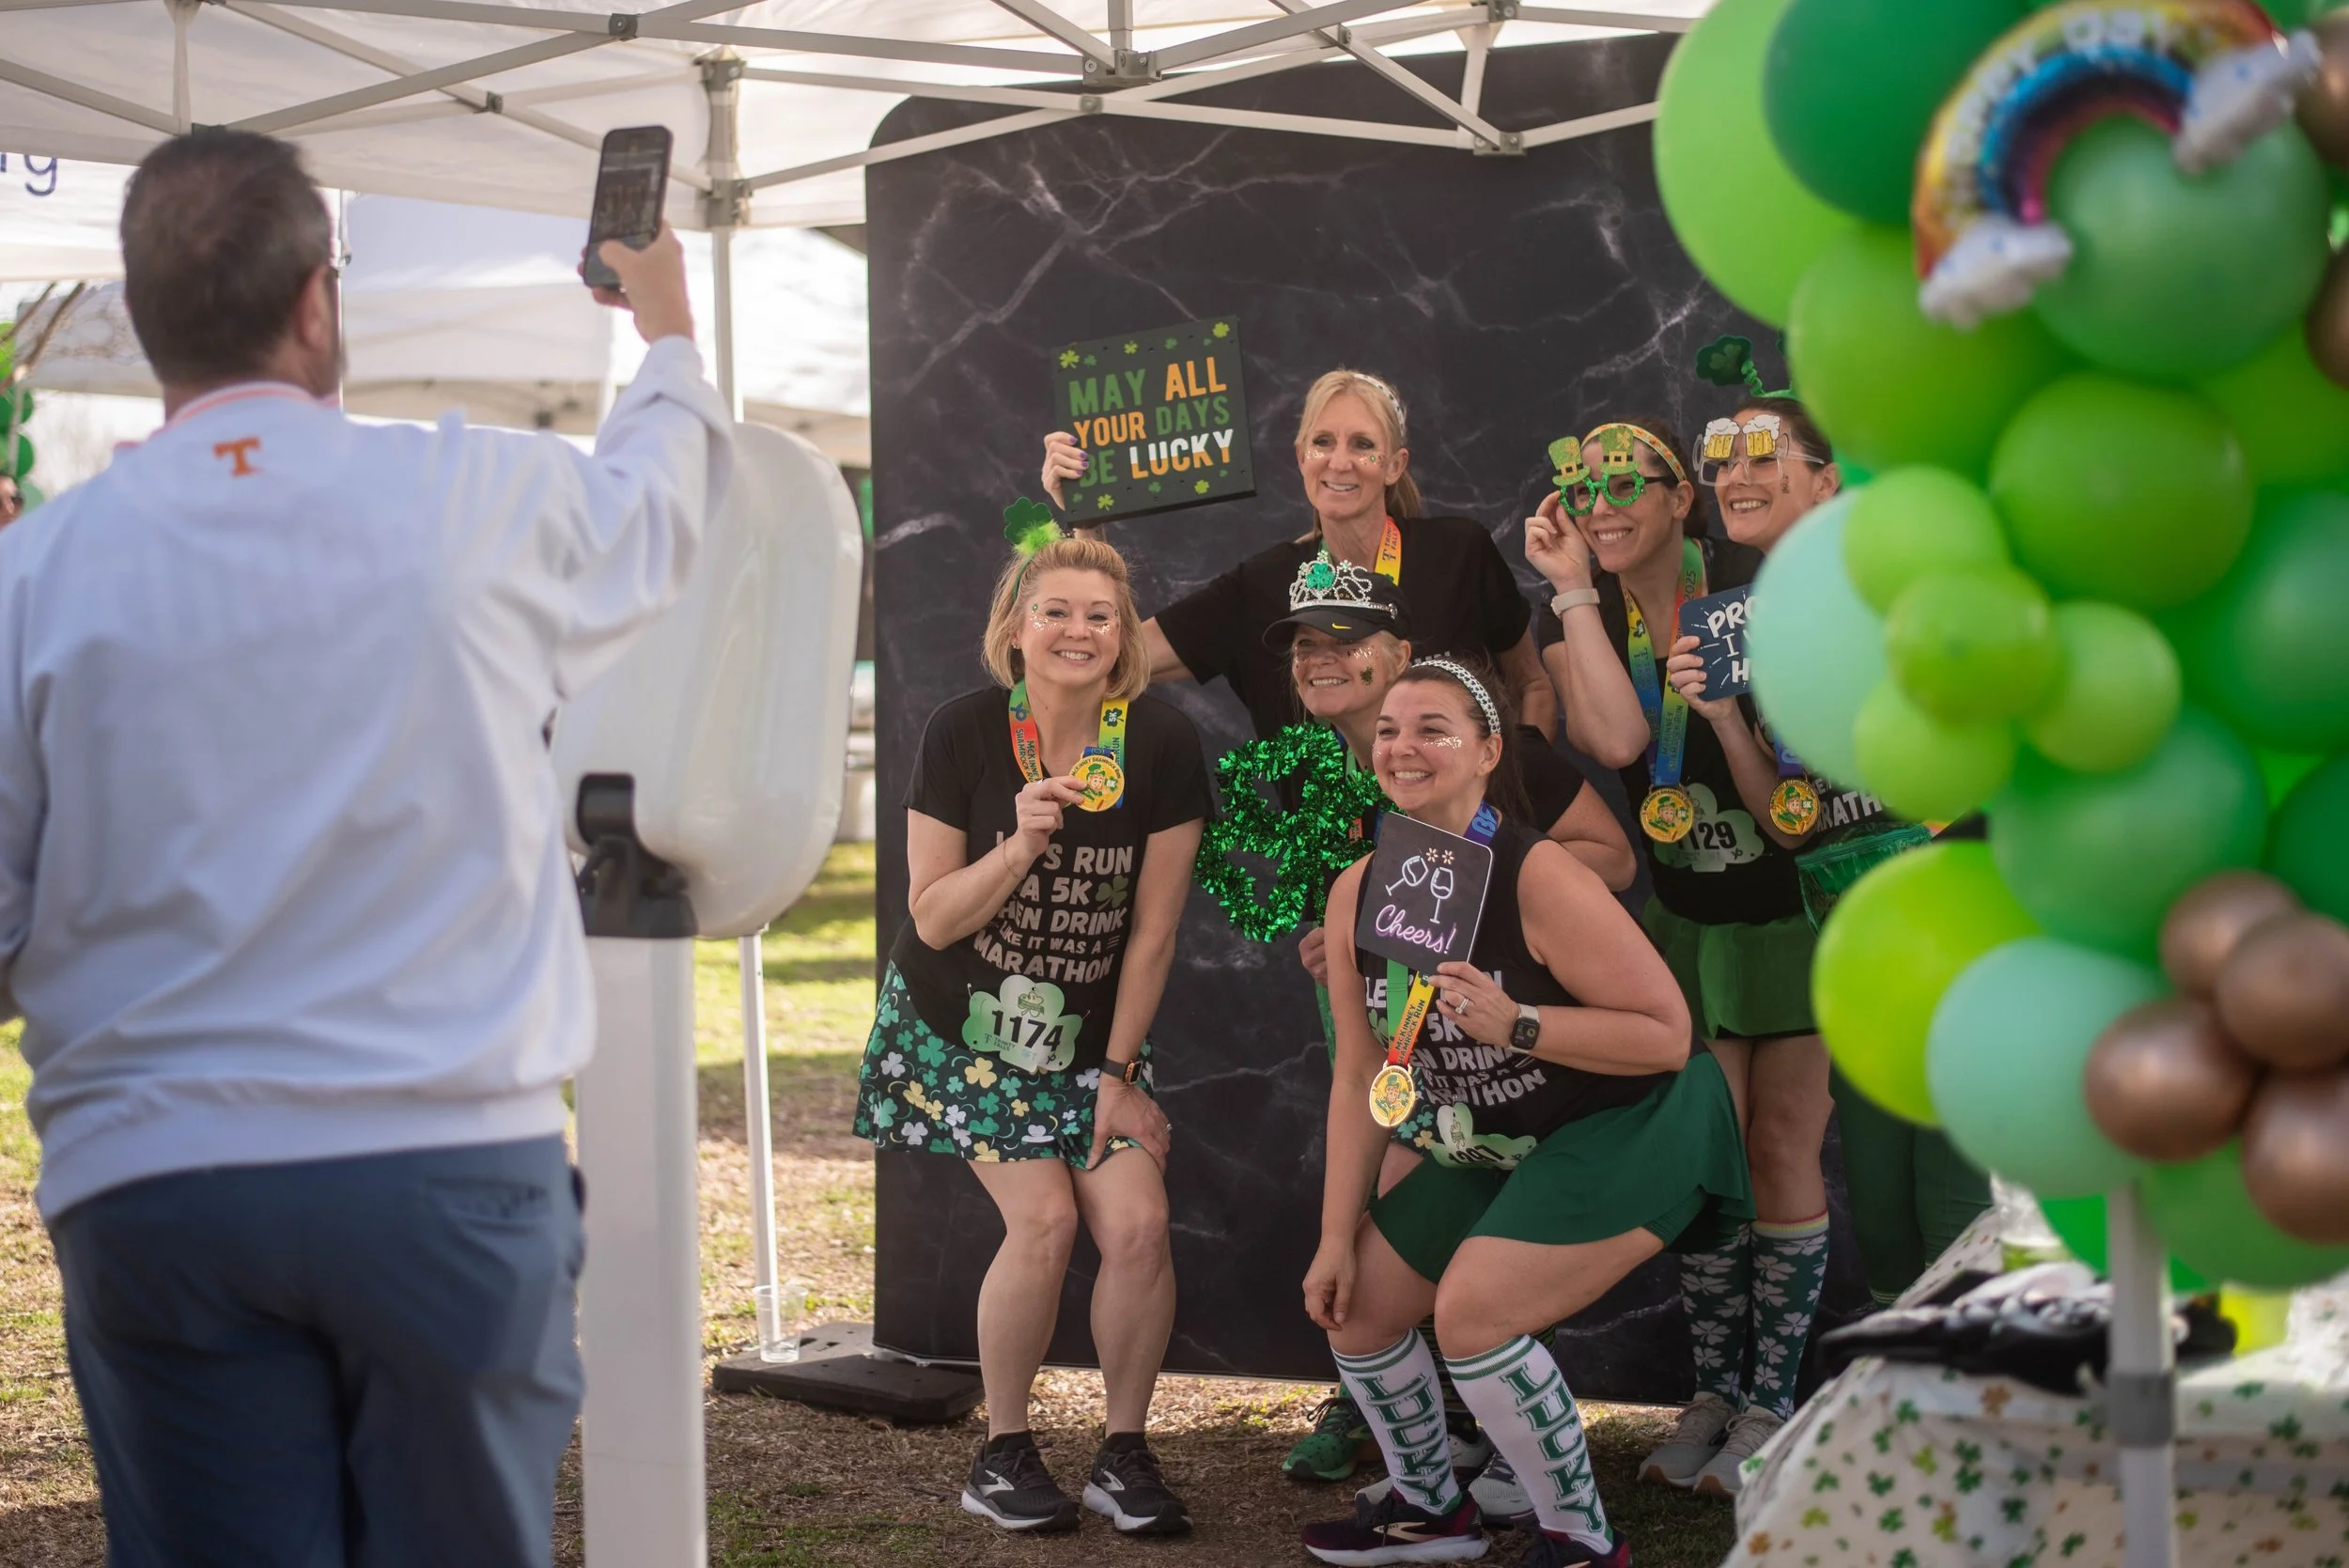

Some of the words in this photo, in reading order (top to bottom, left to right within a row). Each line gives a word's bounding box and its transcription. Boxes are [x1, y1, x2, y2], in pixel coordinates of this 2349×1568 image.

[1068, 368, 1146, 417] MAY
[1165, 356, 1227, 401] ALL
[1073, 411, 1146, 449] YOUR
[1155, 396, 1230, 436] DAYS
[211, 436, 262, 477] T
[1078, 449, 1117, 488] BE
[1128, 428, 1234, 479] LUCKY
[1722, 633, 1739, 658] I
[1016, 728, 1030, 772] SHAMROCK
[1677, 821, 1737, 850] 129
[1073, 846, 1134, 876] RUN
[1019, 874, 1040, 902] A
[1050, 877, 1093, 906] 5K
[998, 899, 1043, 931] HEN
[1050, 907, 1128, 936] DRINK
[1375, 904, 1457, 955] Cheers!
[973, 929, 1115, 984] MARATHON
[1027, 936, 1045, 951] IT
[1050, 938, 1087, 955] WAS
[1091, 940, 1102, 955] A
[1415, 999, 1425, 1019] RUN
[991, 1010, 1064, 1052] 1174
[1425, 1068, 1548, 1106] ARATHON
[1351, 1372, 1452, 1506] LUCKY
[1501, 1361, 1605, 1533] LUCKY
